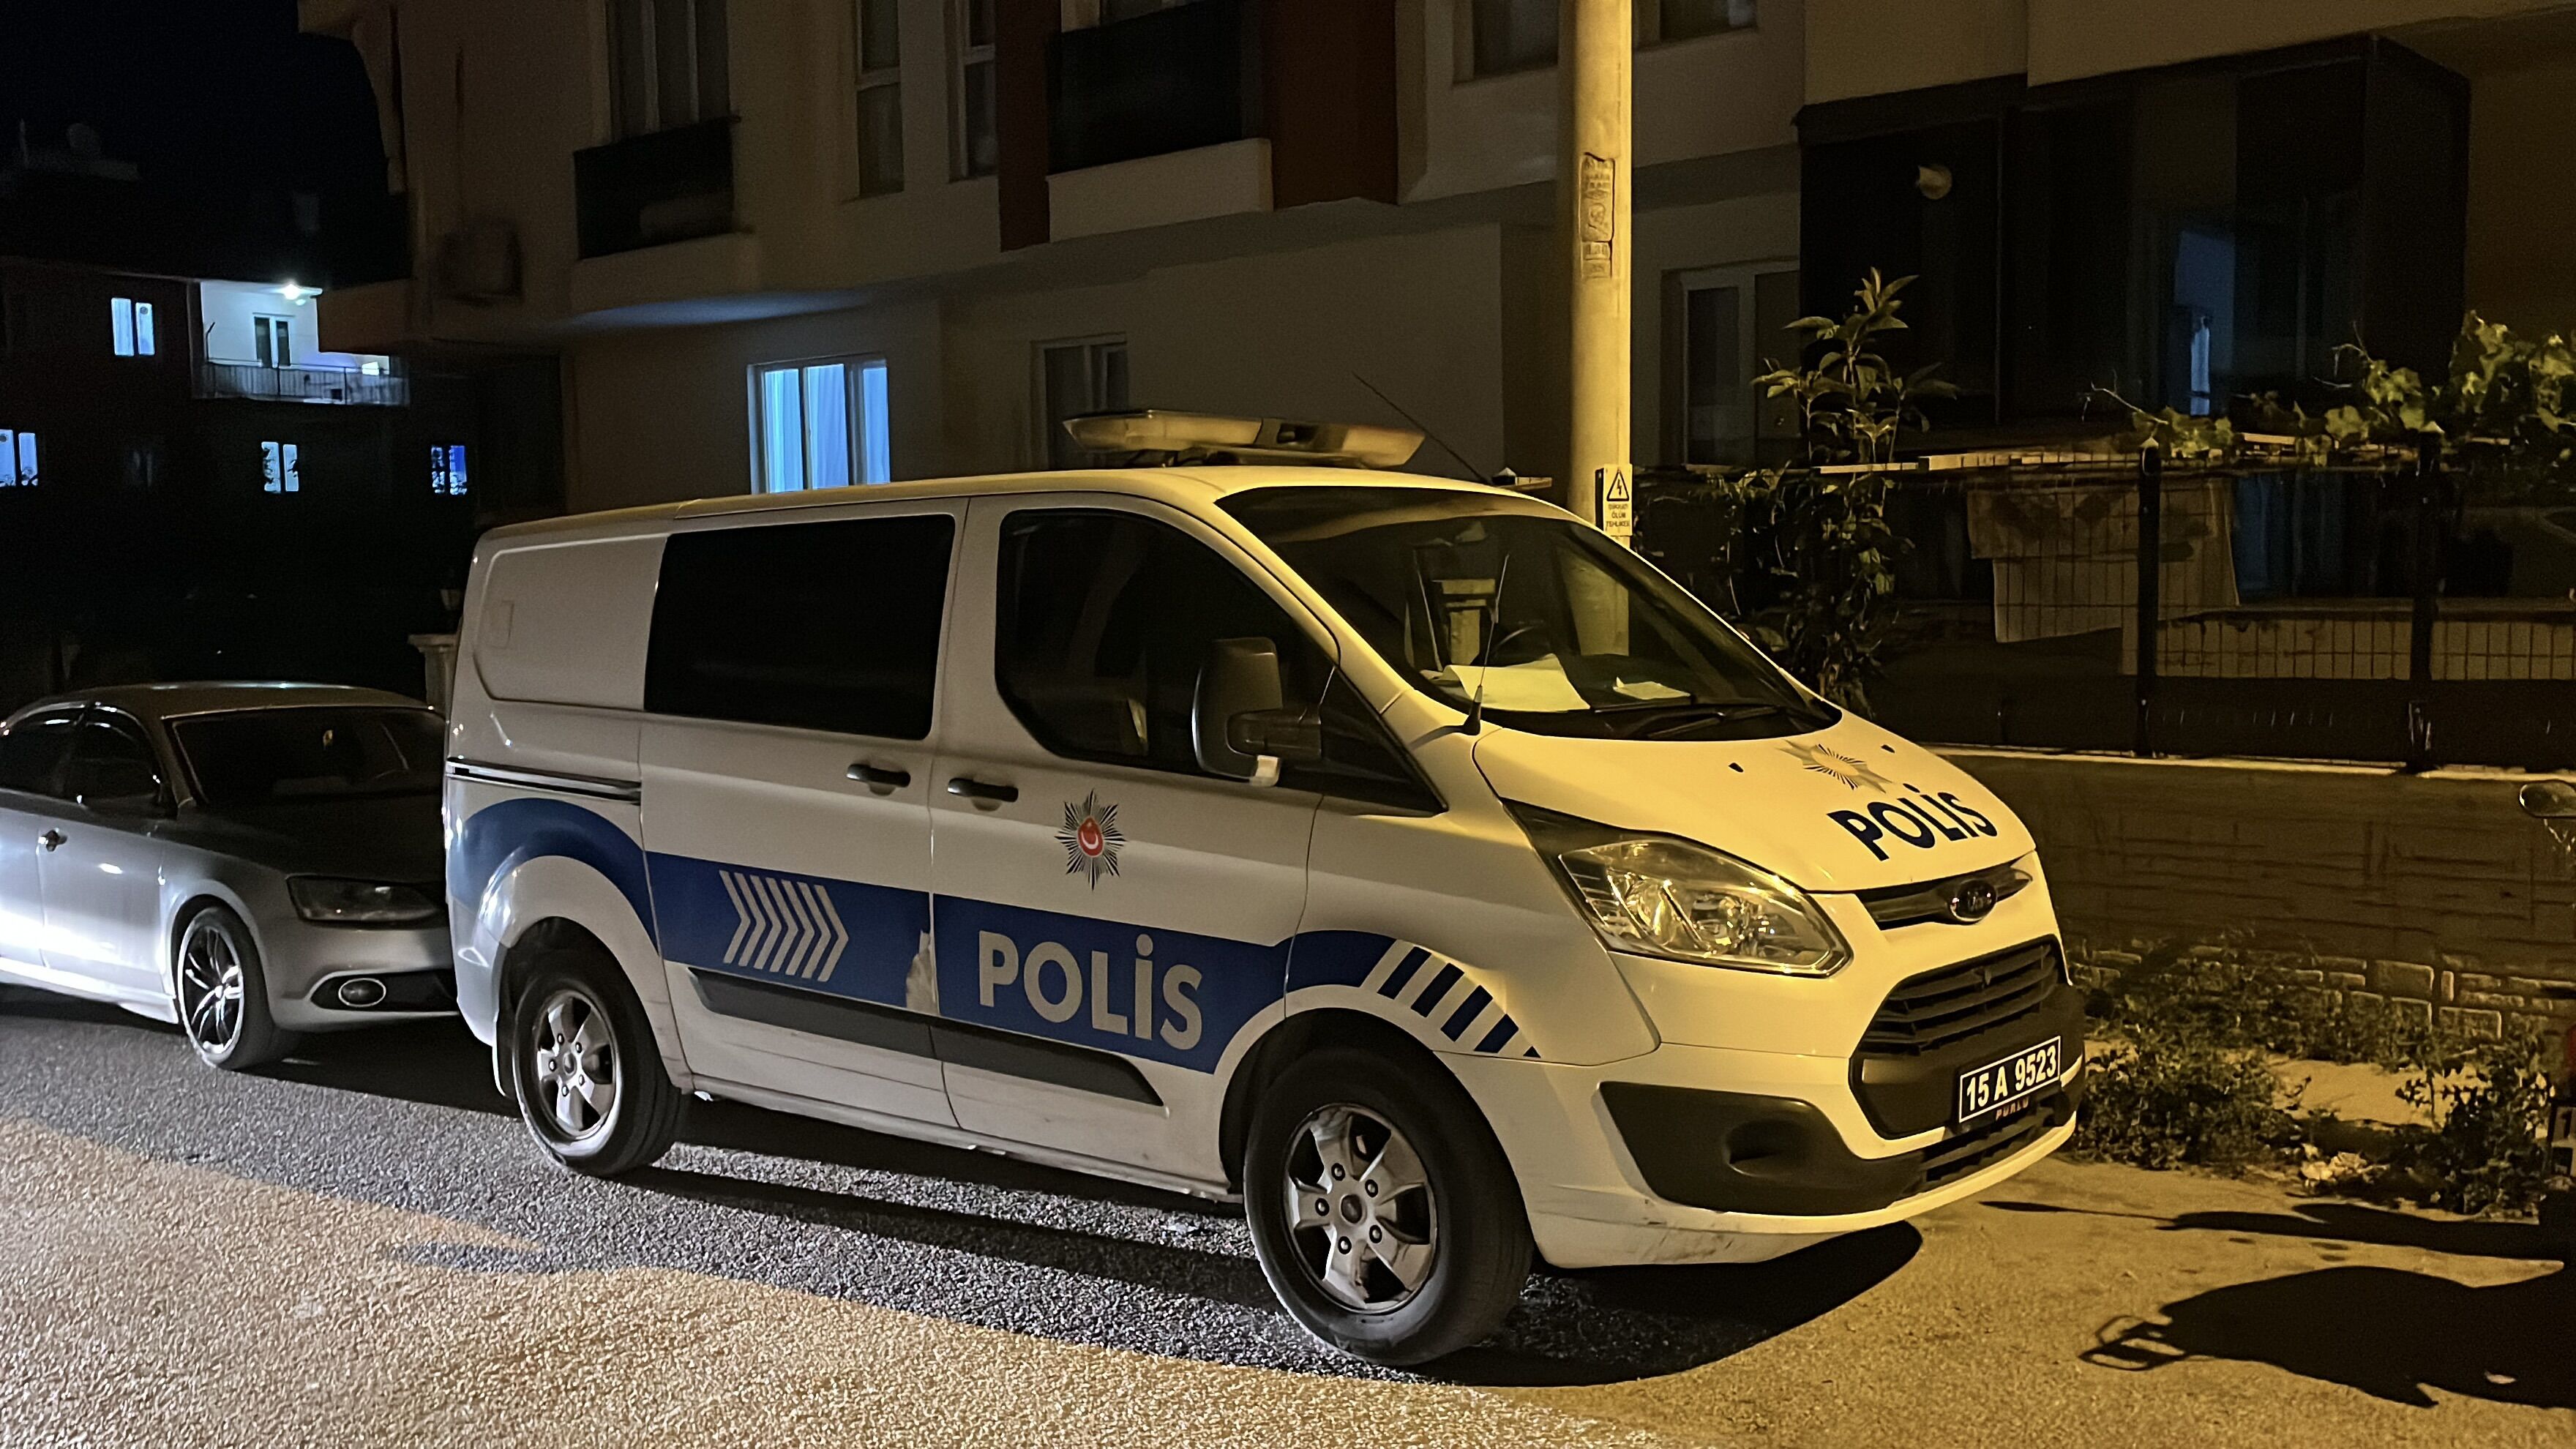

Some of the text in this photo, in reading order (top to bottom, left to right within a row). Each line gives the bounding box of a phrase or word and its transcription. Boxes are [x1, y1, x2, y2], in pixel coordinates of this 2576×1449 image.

[1827, 782, 1998, 862] POLİS
[978, 929, 1202, 1050] POLİS
[1966, 1045, 2057, 1112] 15 A 9523
